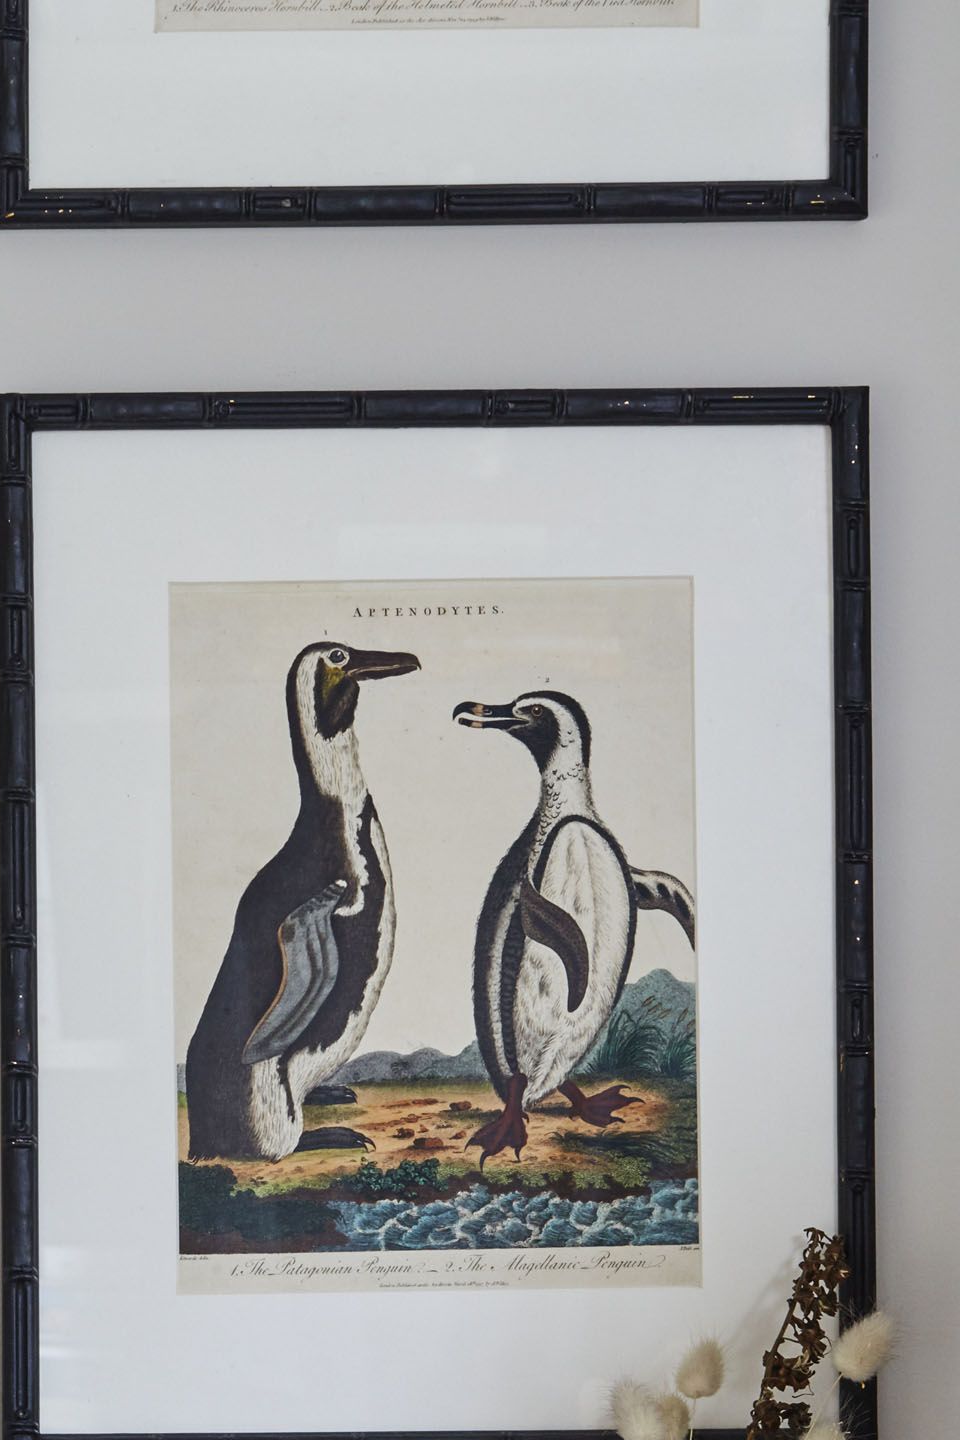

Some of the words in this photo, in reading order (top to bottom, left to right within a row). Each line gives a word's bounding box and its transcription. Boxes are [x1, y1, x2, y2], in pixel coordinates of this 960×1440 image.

[353, 606, 504, 618] APTENODYTES.
[245, 1258, 269, 1276] The
[276, 1257, 352, 1279] Patagonian
[458, 1254, 487, 1272] The
